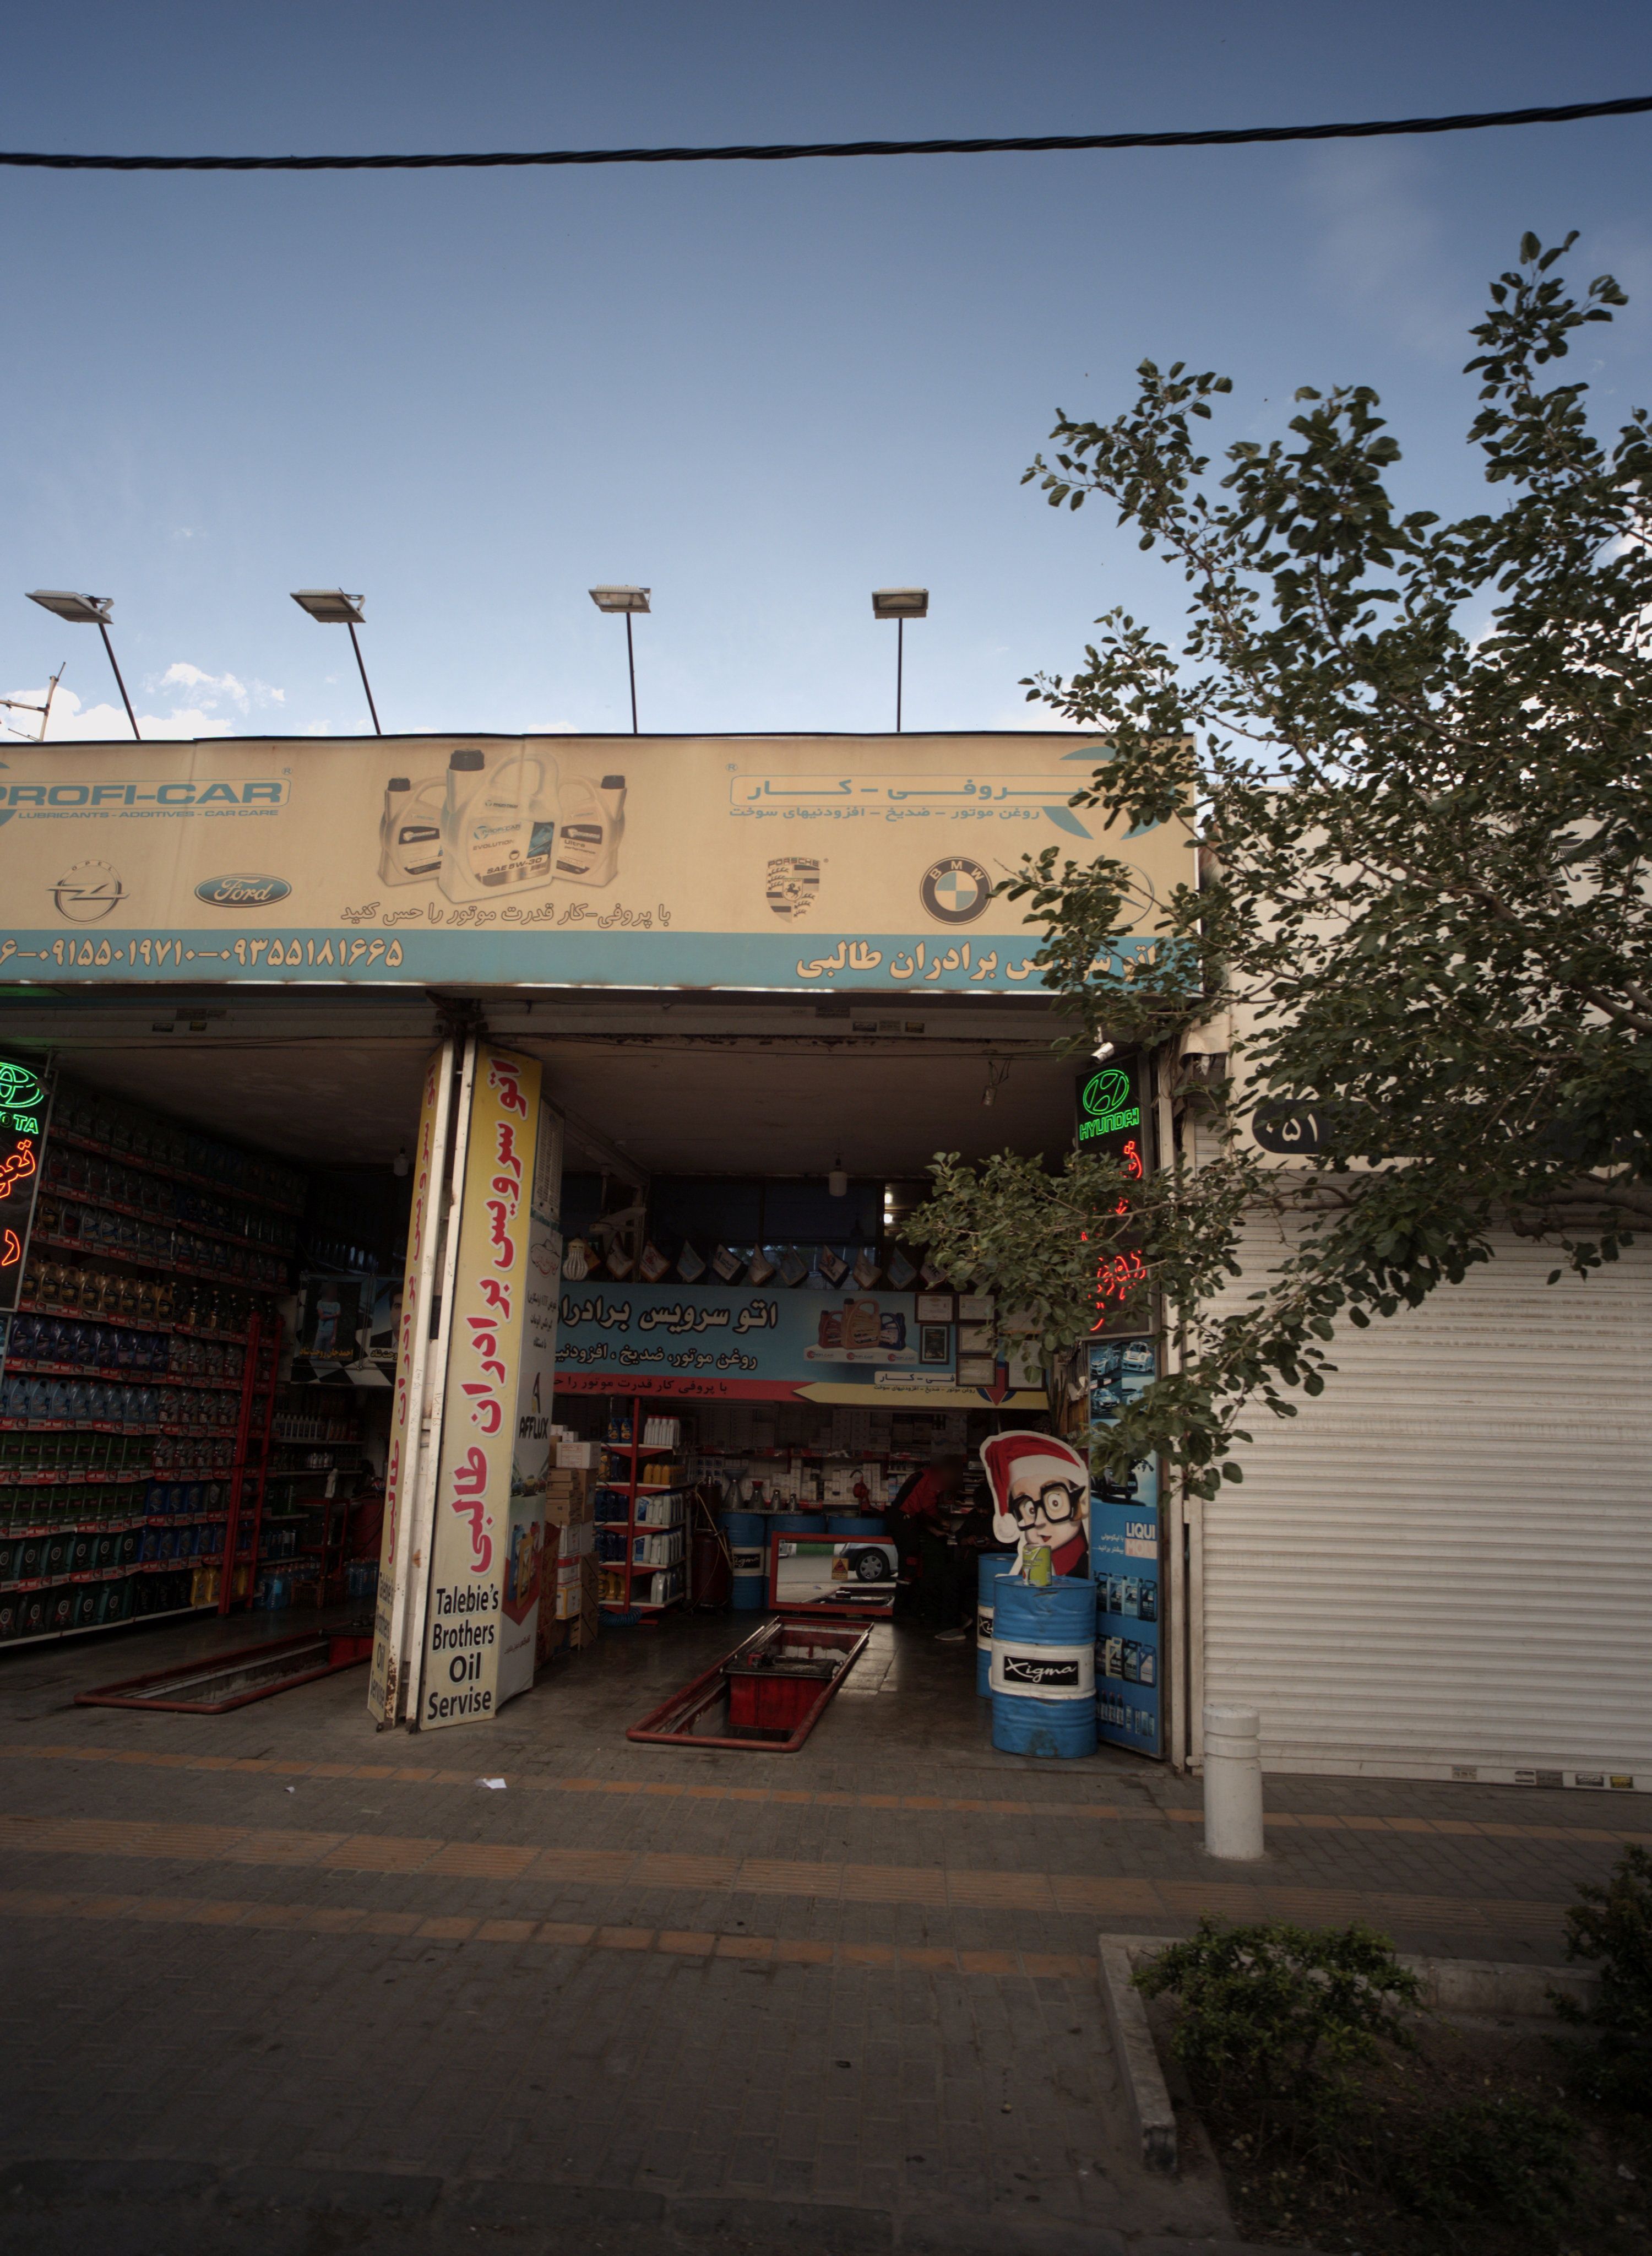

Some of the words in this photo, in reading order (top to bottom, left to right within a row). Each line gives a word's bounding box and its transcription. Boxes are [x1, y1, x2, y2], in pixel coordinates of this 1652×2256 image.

[0, 782, 284, 806] ROFI-CAR
[888, 779, 1085, 800] روفی
[729, 806, 779, 819] سوخت
[885, 807, 931, 822] ضدیخ
[950, 807, 995, 820] موتور
[998, 807, 1040, 820] روغن
[487, 864, 507, 875] SAE
[508, 857, 542, 870] 5W-30
[768, 857, 819, 868] PORSCHE
[929, 859, 985, 881] BMW
[214, 876, 273, 902] Ford
[341, 902, 381, 924] کنید
[383, 905, 424, 926] حس
[428, 903, 444, 924] را
[447, 906, 496, 926] موتور
[501, 903, 554, 923] قدرت
[659, 904, 671, 927] با
[796, 940, 882, 979] طالبی
[889, 942, 998, 981] برادران
[487, 1057, 528, 1121] اتو
[1079, 1107, 1140, 1141] HYUNDAI
[485, 1120, 524, 1271] سرویس
[558, 1294, 632, 1332] برادرا
[639, 1302, 731, 1334] سرویس
[732, 1299, 779, 1333] اتو
[554, 1342, 608, 1364] افزودنی
[618, 1344, 665, 1366] ضدیخ
[716, 1347, 758, 1371] روغن
[582, 1378, 614, 1390] موتور
[617, 1379, 653, 1390] قدرت
[719, 1381, 727, 1393] با
[519, 1415, 550, 1440] AFFLUX
[451, 1445, 495, 1576] طالبی
[1126, 1522, 1156, 1540] LIQUI
[436, 1585, 499, 1616] Talebie's
[432, 1622, 495, 1651] Brothers
[448, 1652, 482, 1684] Oil
[1005, 1657, 1077, 1683] Xigma
[427, 1688, 492, 1721] Servise
